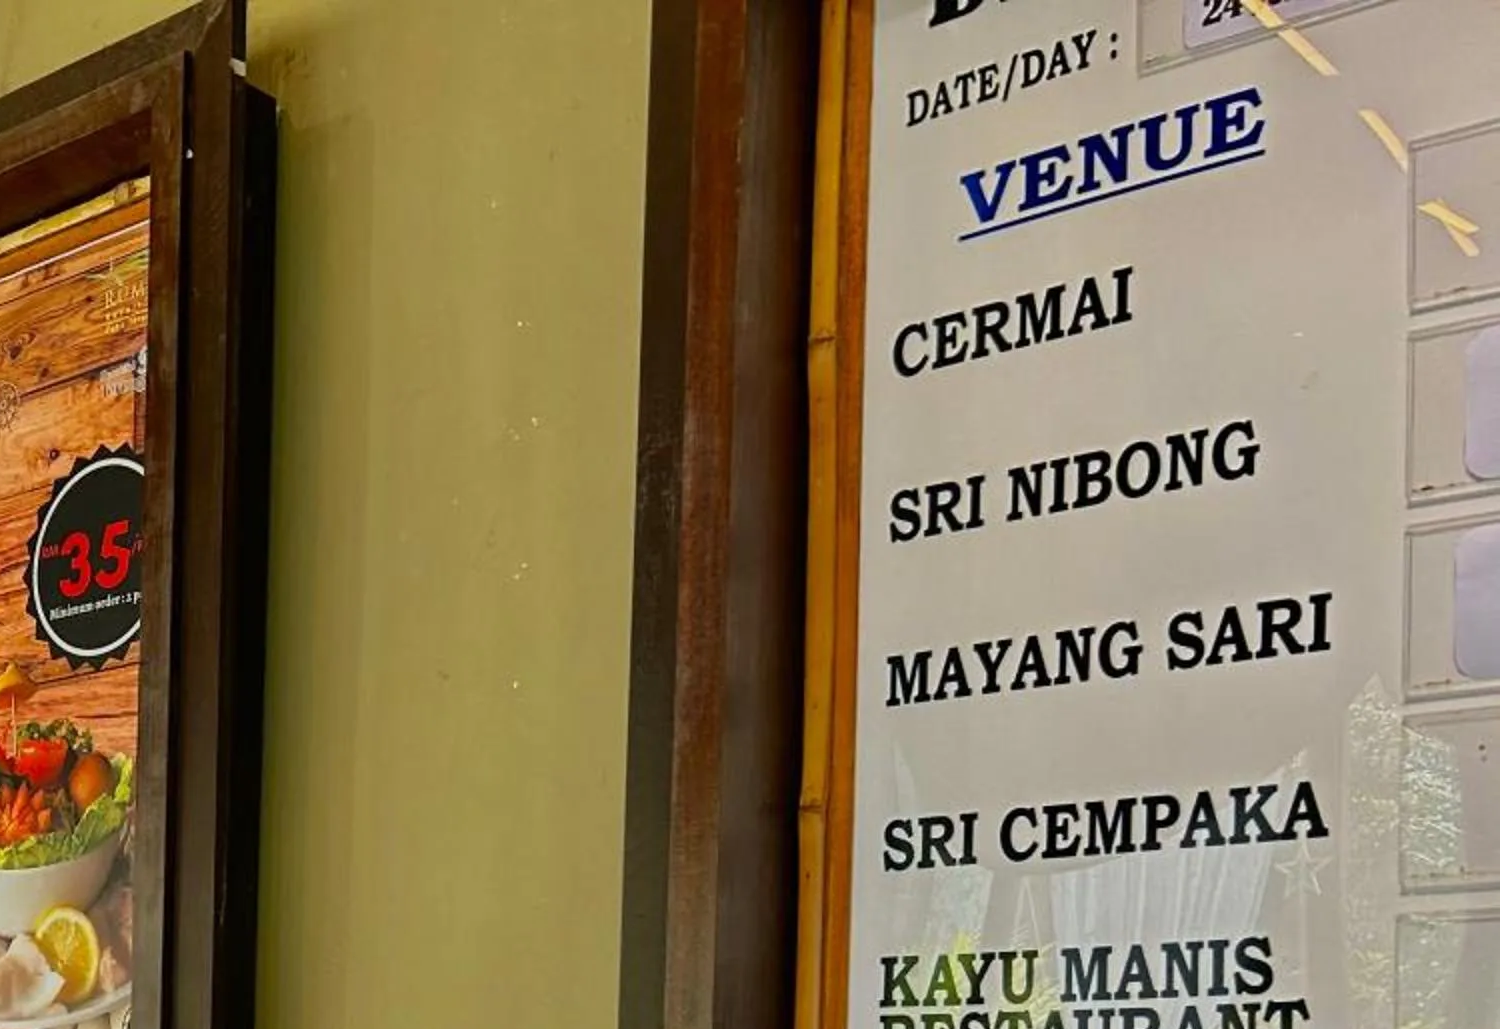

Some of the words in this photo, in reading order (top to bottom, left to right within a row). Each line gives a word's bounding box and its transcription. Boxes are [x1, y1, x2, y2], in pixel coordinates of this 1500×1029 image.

[906, 30, 1098, 127] DATE/DAY
[958, 86, 1267, 224] VENUE
[893, 266, 1134, 377] CERMAI
[889, 474, 985, 543] SRI
[1006, 420, 1261, 522] NIBONG
[59, 520, 131, 597] 35
[886, 621, 1143, 707] MAYANG
[1167, 592, 1333, 670] SARI
[883, 812, 979, 871] SRI
[1000, 781, 1329, 863] CEMPAKA
[879, 949, 1039, 1007] KAYU
[1061, 937, 1273, 1002] MANIS
